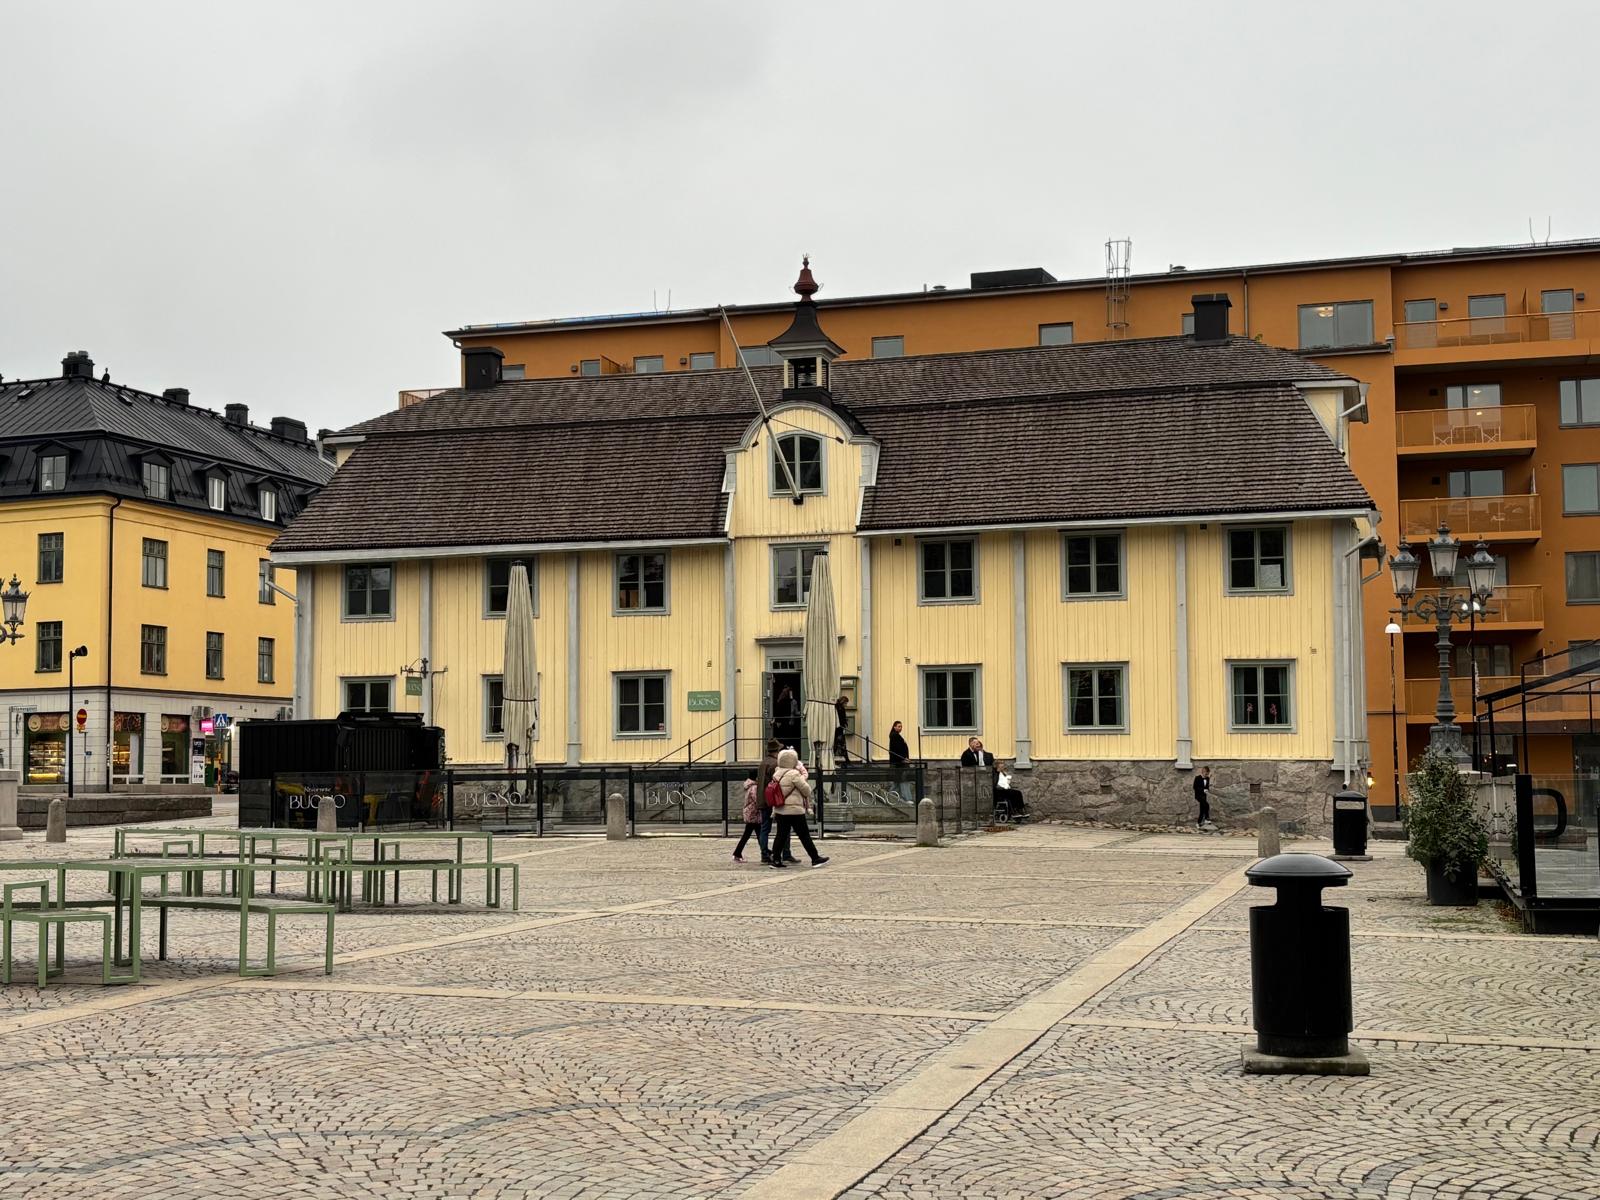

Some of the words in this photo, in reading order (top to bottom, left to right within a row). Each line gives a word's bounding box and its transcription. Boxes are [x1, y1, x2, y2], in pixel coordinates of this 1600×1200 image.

[289, 794, 346, 809] BUOO
[646, 790, 707, 805] BUONO
[836, 790, 900, 806] BUONO
